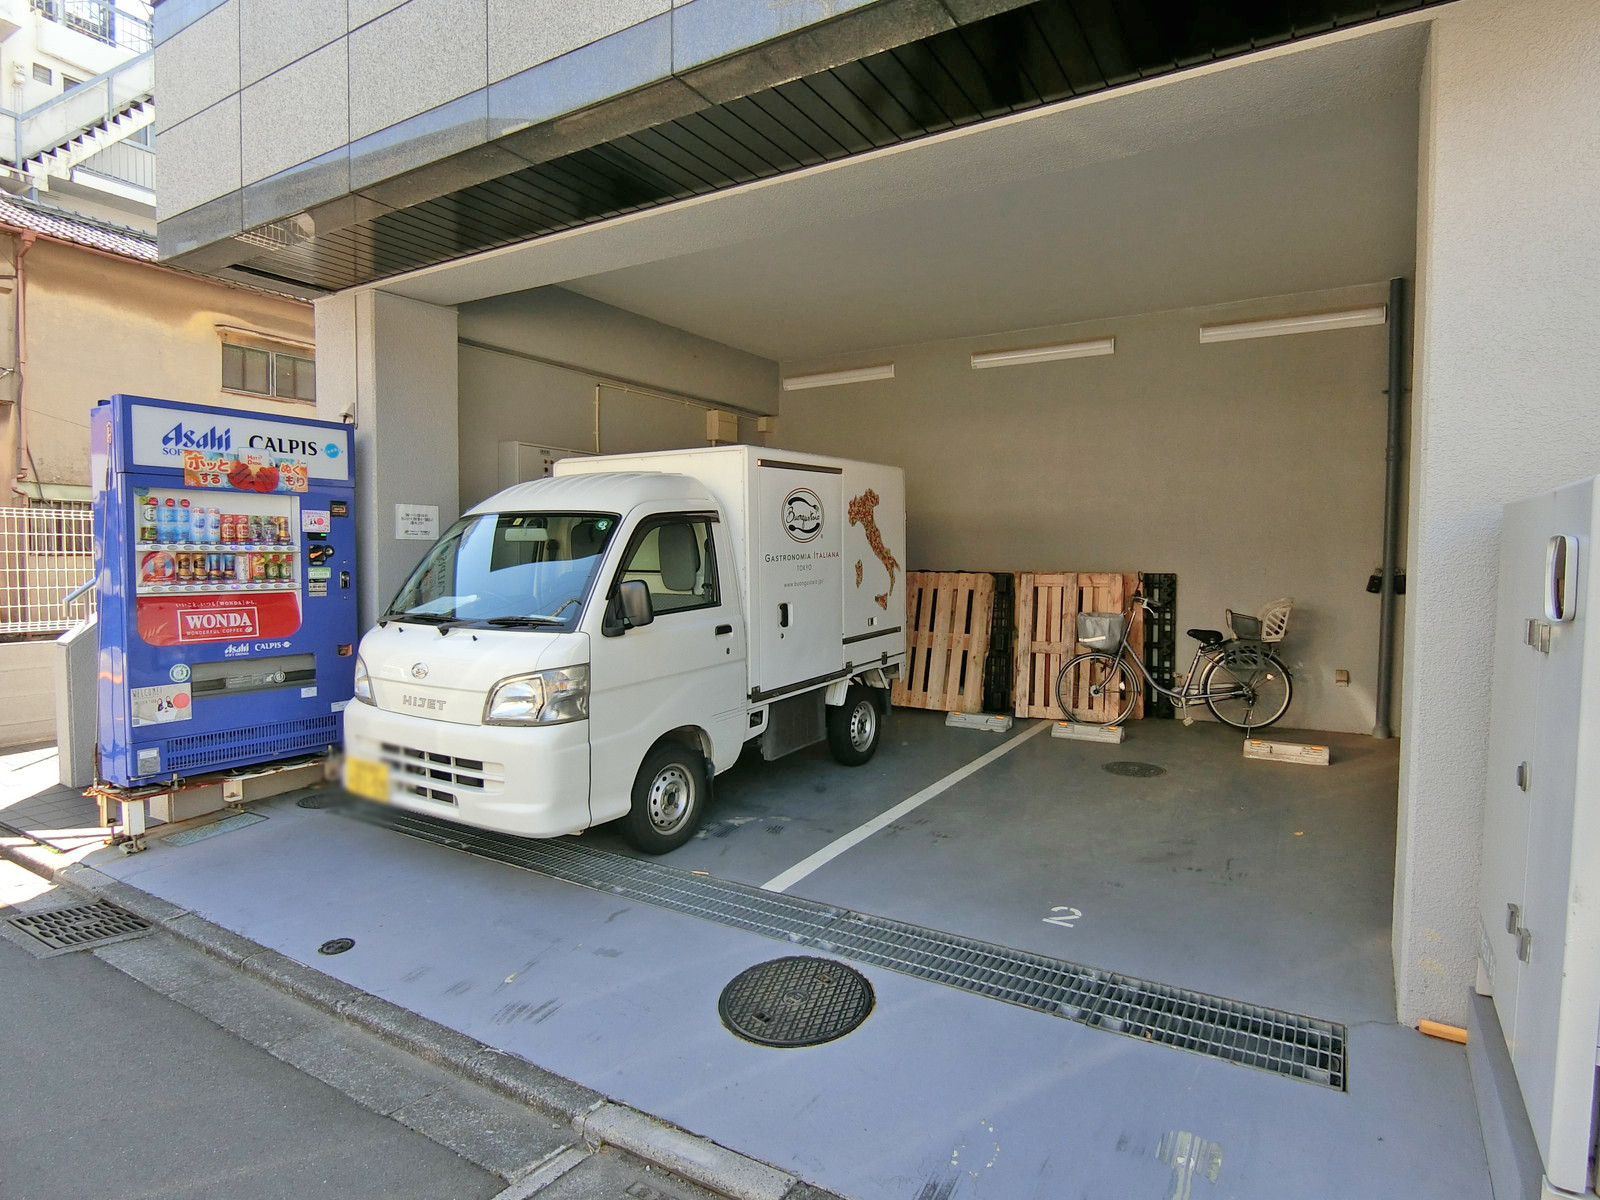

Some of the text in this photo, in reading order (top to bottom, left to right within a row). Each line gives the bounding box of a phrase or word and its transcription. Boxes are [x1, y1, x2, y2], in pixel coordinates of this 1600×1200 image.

[162, 422, 231, 451] Asahi
[249, 435, 318, 456] CALPIS
[187, 453, 230, 473] ホッと
[280, 463, 301, 475] ぬく
[199, 472, 221, 484] する
[285, 475, 306, 488] もり
[813, 551, 840, 560] ITALIANA
[185, 612, 252, 629] WONDA
[224, 643, 250, 654] Asahi
[254, 641, 282, 652] CALPIS
[402, 694, 447, 711] HIJET
[1042, 906, 1082, 928] 2
